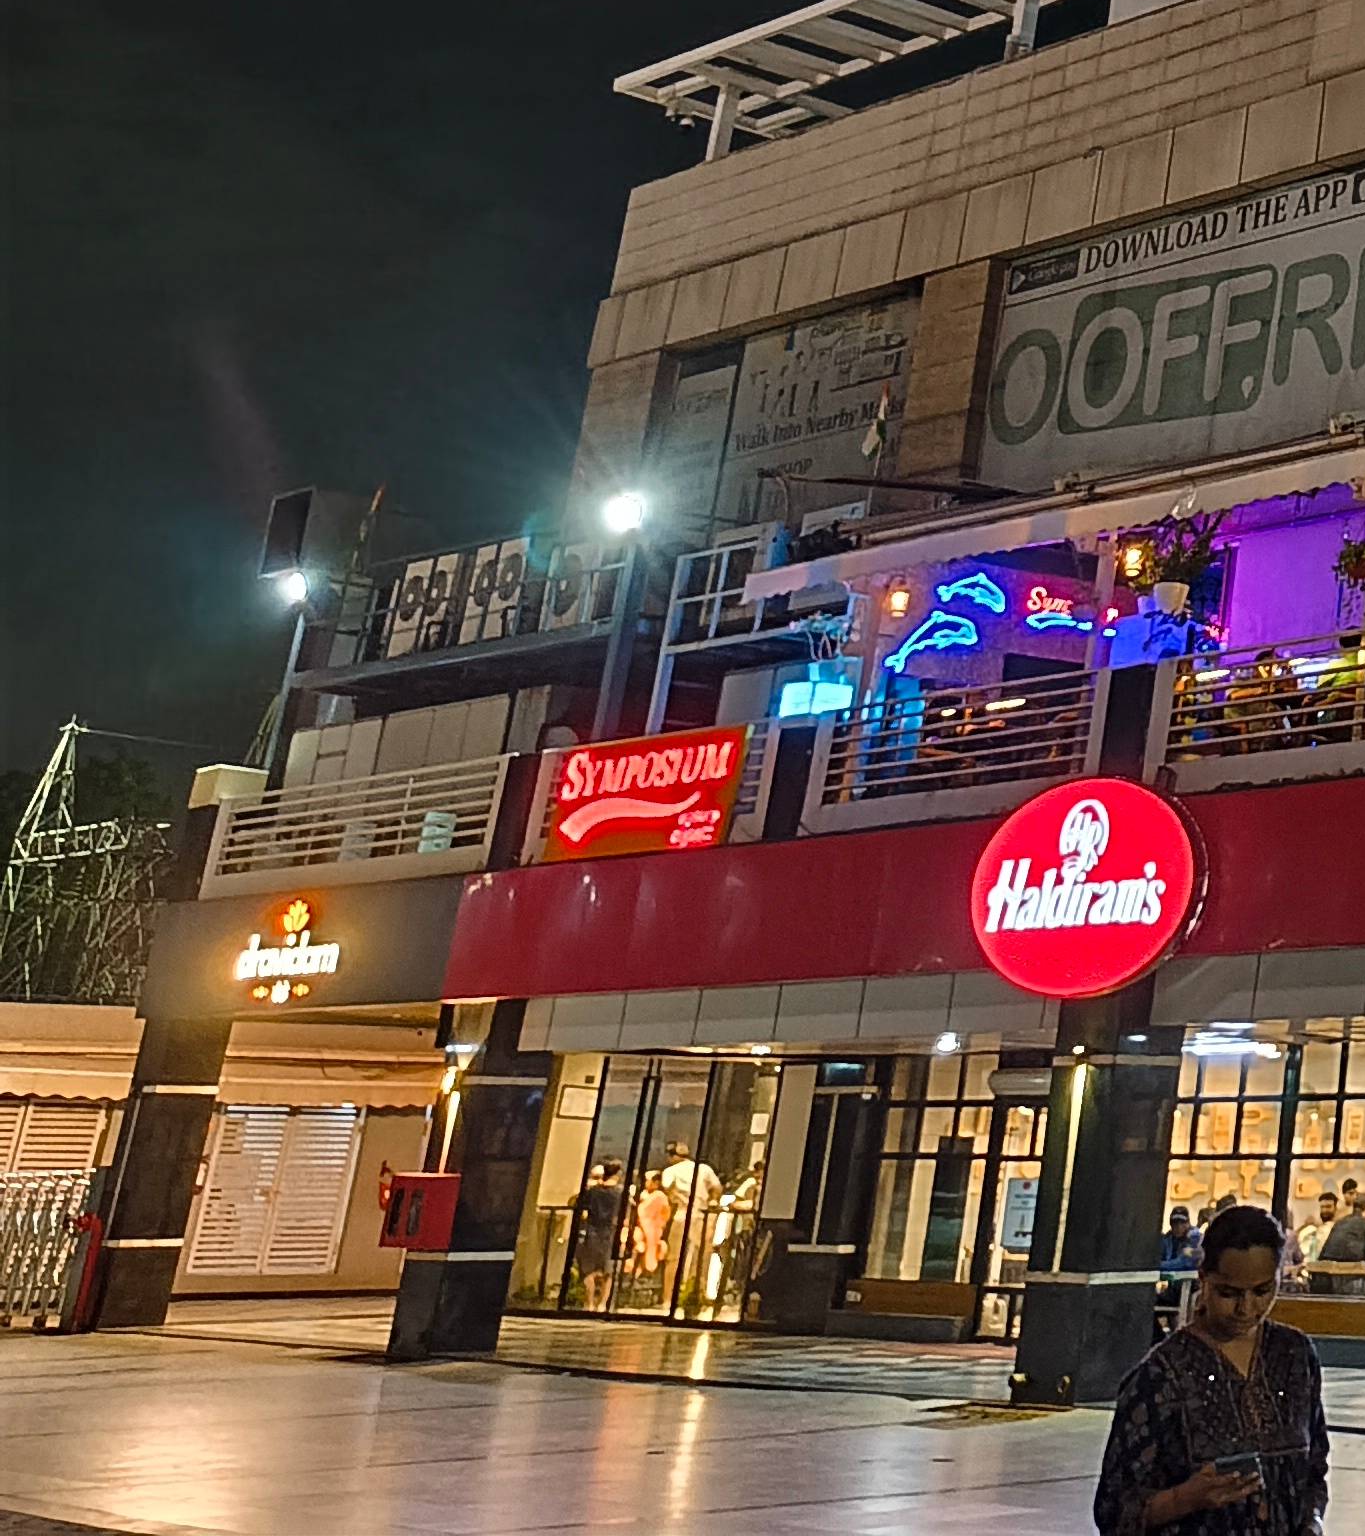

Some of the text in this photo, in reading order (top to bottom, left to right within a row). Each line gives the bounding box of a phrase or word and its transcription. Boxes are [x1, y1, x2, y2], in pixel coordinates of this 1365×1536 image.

[1086, 178, 1347, 275] DOWNLOAD THE APP
[560, 741, 735, 801] SYMPOSIUM
[984, 857, 1167, 934] Haldiram's
